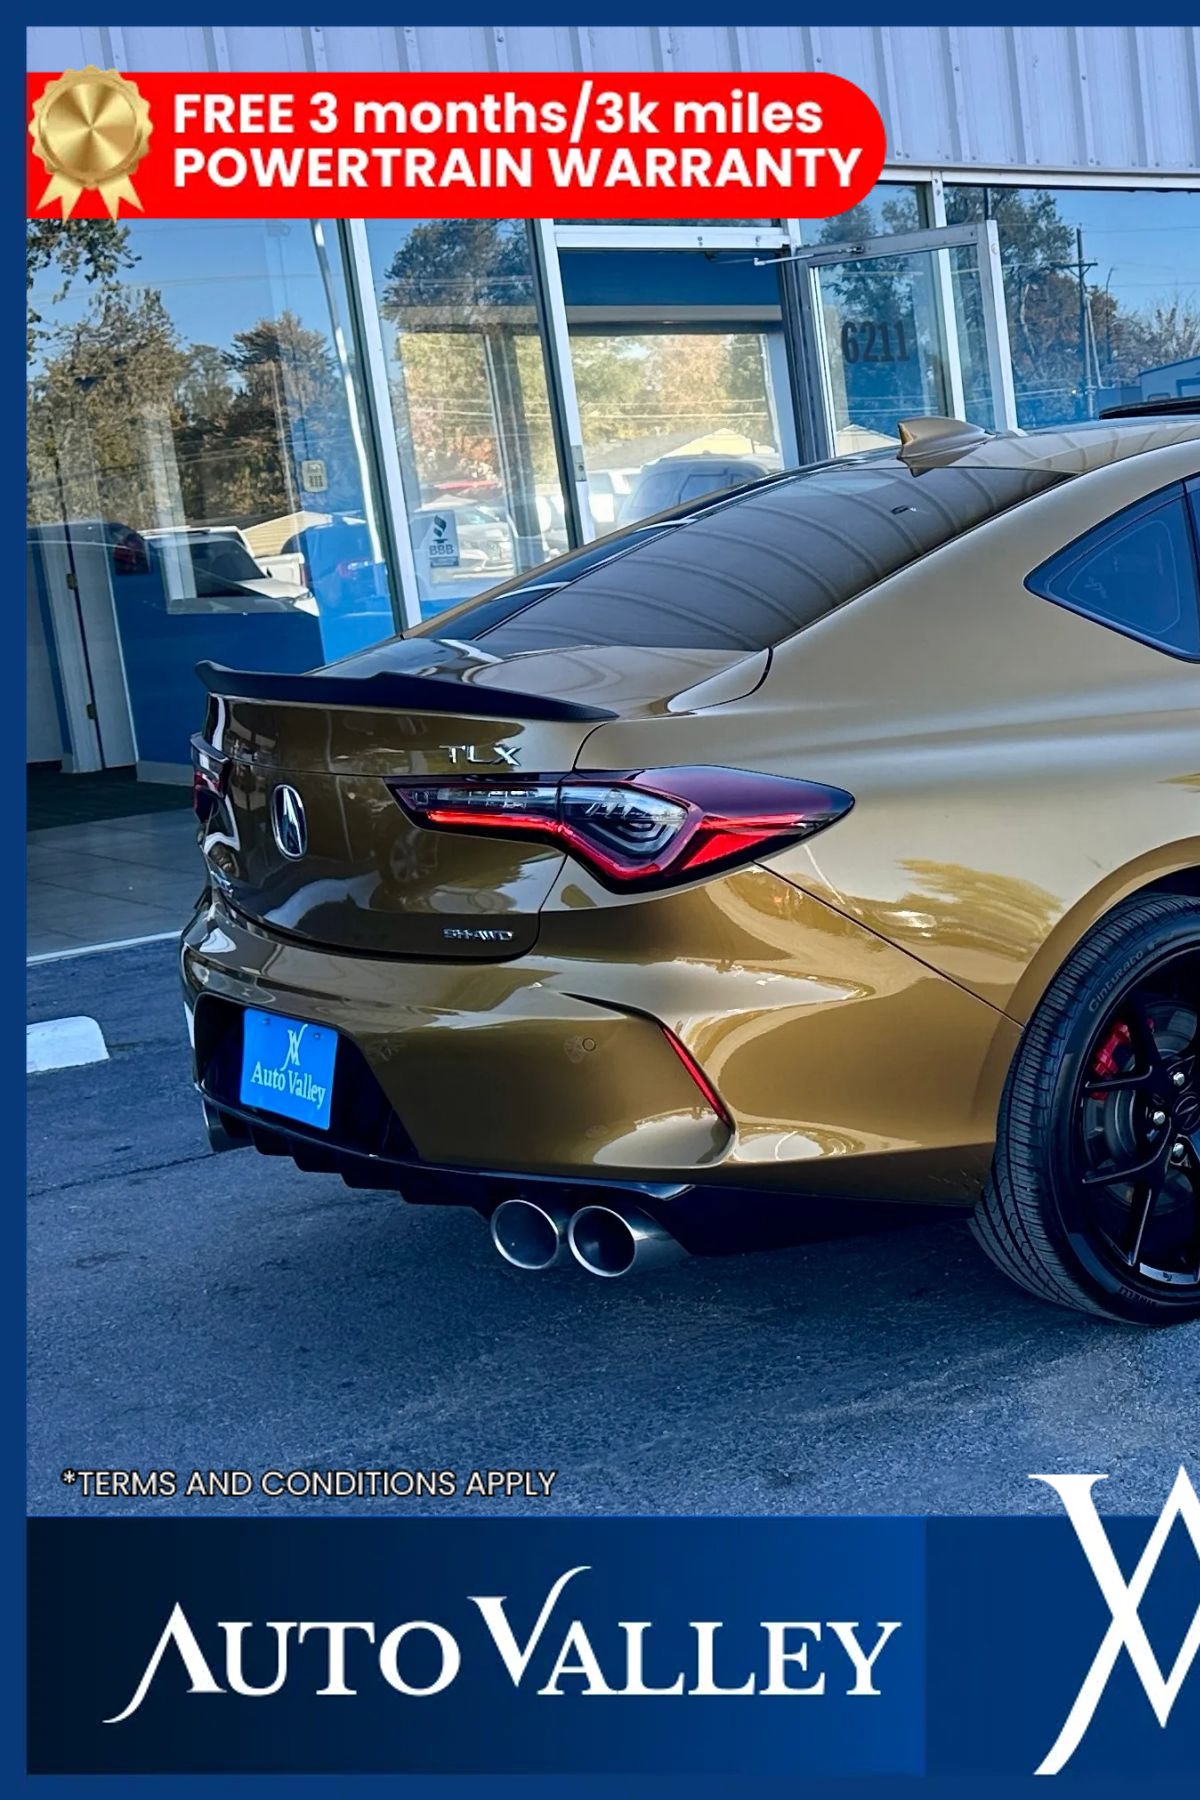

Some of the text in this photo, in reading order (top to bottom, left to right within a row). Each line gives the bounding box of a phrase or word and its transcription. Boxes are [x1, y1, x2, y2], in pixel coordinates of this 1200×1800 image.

[841, 321, 911, 364] 6211
[429, 544, 454, 556] BBB
[439, 744, 522, 767] TLX
[250, 1060, 327, 1110] Auto Valley
